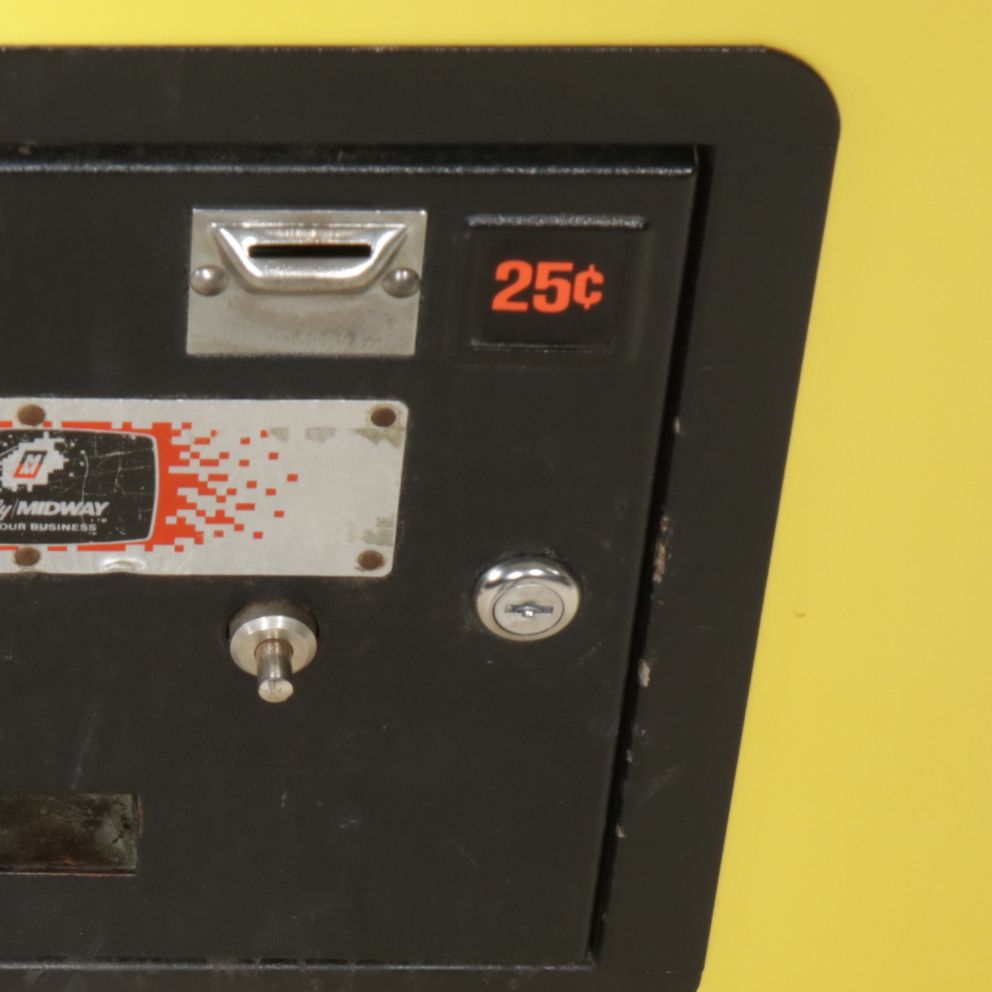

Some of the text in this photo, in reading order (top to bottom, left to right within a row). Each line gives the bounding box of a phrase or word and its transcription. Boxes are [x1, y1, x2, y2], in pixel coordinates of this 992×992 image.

[491, 260, 604, 313] 25¢
[0, 522, 26, 531] OUR
[30, 523, 97, 532] BUSINESS
